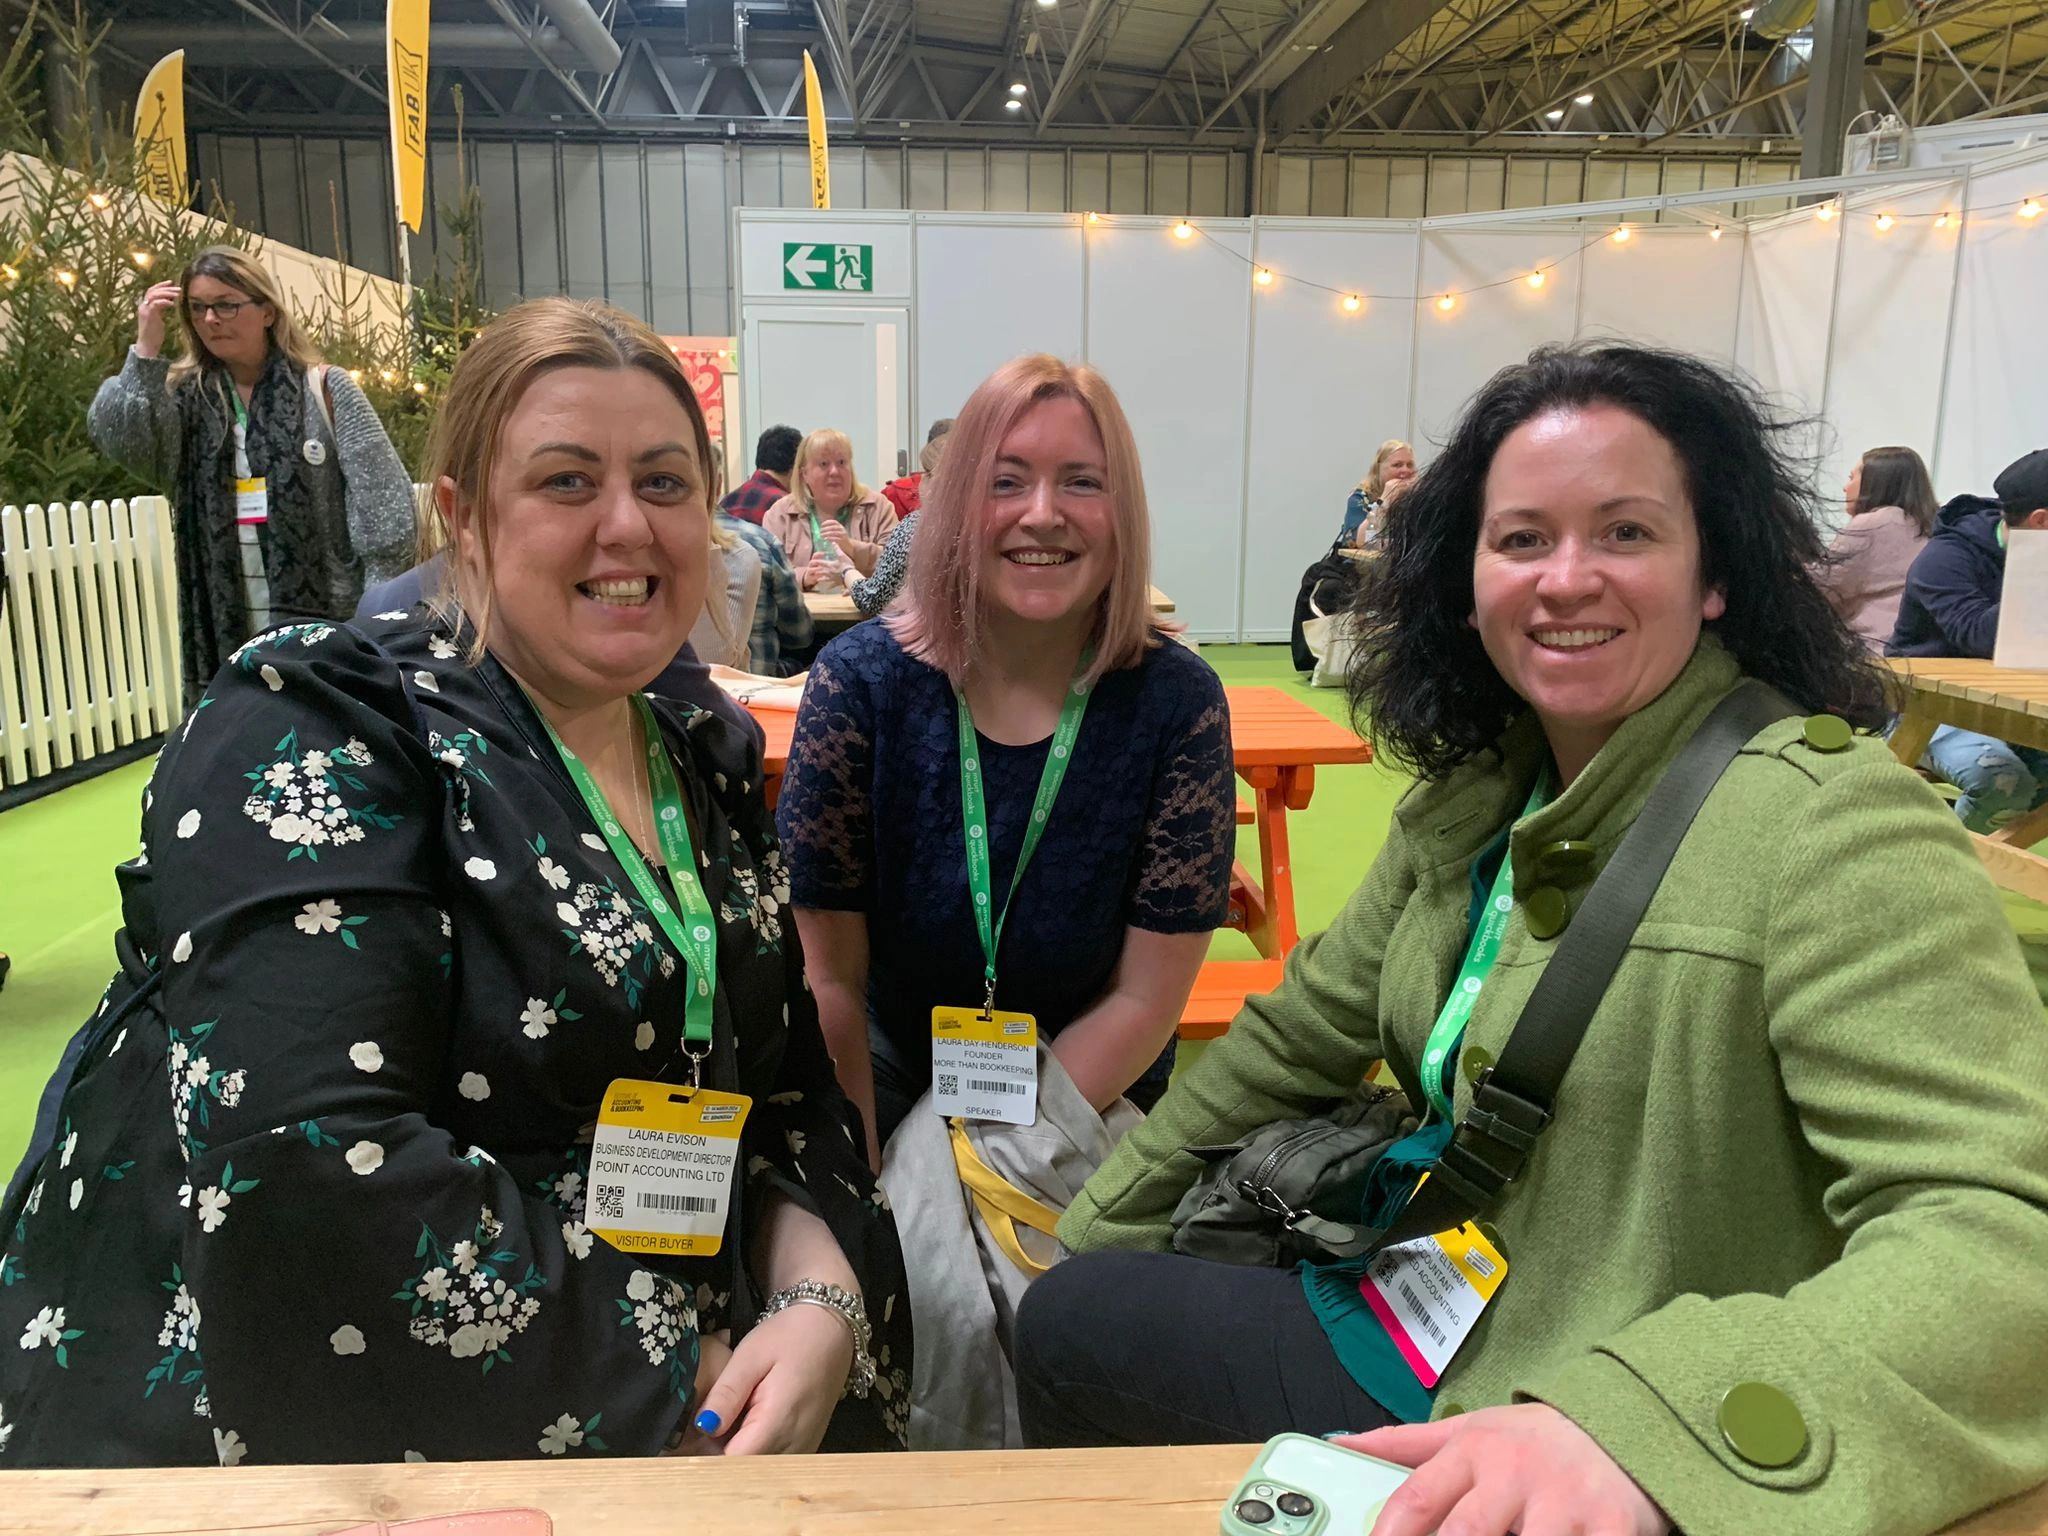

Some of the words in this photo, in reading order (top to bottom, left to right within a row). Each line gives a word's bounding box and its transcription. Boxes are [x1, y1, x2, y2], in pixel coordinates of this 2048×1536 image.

[406, 93, 420, 146] FAB
[582, 772, 612, 821] quickbooks
[965, 772, 975, 815] quickbooks
[626, 848, 659, 897] quickbooks
[969, 839, 980, 882] quickbooks
[1474, 910, 1498, 963] quickbooks
[934, 1059, 956, 1068] MORE
[959, 1061, 978, 1069] THAN
[980, 1062, 1033, 1075] BOOKKEEPING
[964, 1050, 1003, 1060] FOUNDER
[965, 1106, 1002, 1116] SPEAKER
[595, 1143, 635, 1157] BUSINESS
[637, 1147, 693, 1163] DEVELOPMENT
[693, 1153, 732, 1166] DIRECTOR
[628, 1128, 664, 1143] LAURA
[667, 1133, 707, 1147] EVISON
[596, 1161, 631, 1174] POINT
[632, 1164, 704, 1181] ACCOUNTING
[705, 1171, 725, 1183] LTD
[615, 1235, 657, 1247] VISITOR
[660, 1238, 694, 1250] BUYER
[1413, 1240, 1455, 1296] ACCOUNTANT
[1438, 1249, 1468, 1289] FELTHAM
[1418, 1271, 1461, 1327] ACCOUNTING
